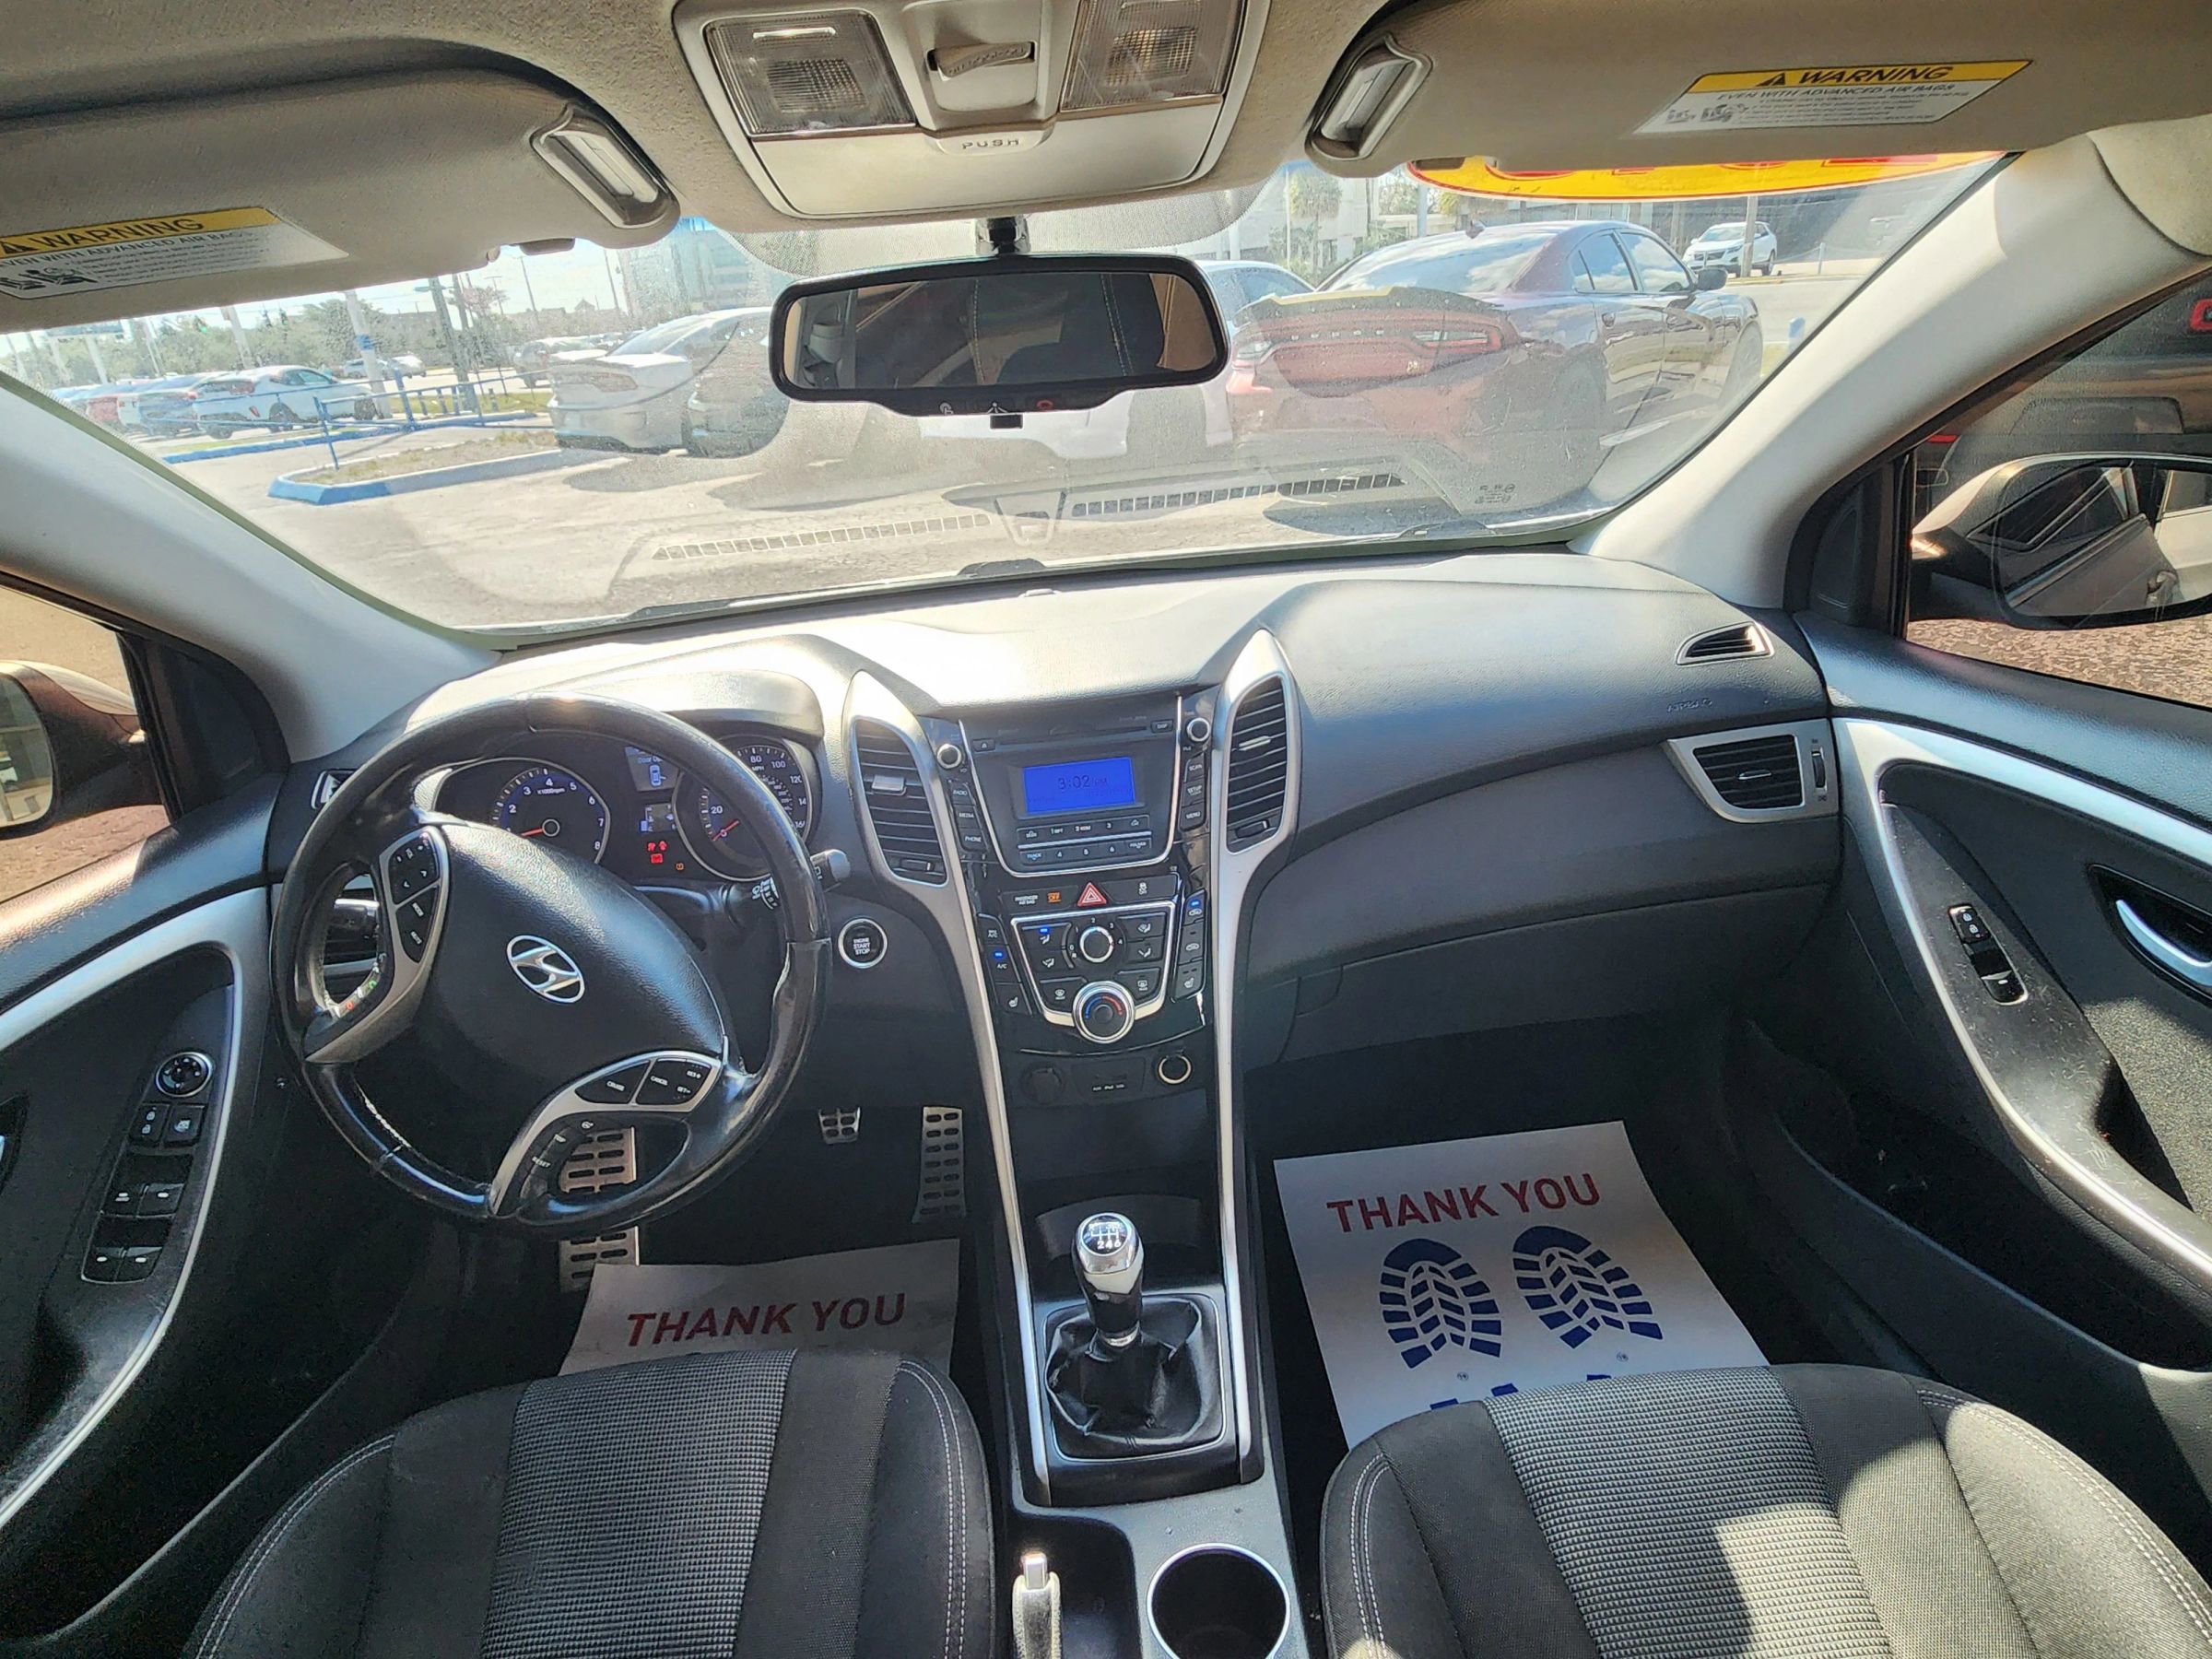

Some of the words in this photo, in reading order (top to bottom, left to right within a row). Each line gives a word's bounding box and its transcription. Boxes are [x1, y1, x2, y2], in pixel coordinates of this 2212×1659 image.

[1798, 66, 1954, 85] WARNING
[961, 138, 1020, 149] PUSH
[29, 218, 205, 248] WARNING
[87, 240, 174, 255] ADVANCED
[179, 235, 206, 244] AIR
[771, 760, 787, 769] 100
[545, 778, 554, 787] 4
[570, 782, 578, 791] 5
[523, 785, 532, 795] 3
[588, 796, 596, 806] 6
[508, 804, 517, 814] 2
[710, 805, 724, 814] 20
[597, 818, 605, 828] 7
[594, 841, 601, 851] 8
[532, 1156, 551, 1168] RESET
[1326, 1184, 1500, 1233] THANK
[1500, 1173, 1601, 1215] YOU
[1096, 1239, 1105, 1250] 2
[1113, 1240, 1122, 1248] 6
[627, 1302, 798, 1347] THANK
[811, 1292, 906, 1332] YOU
